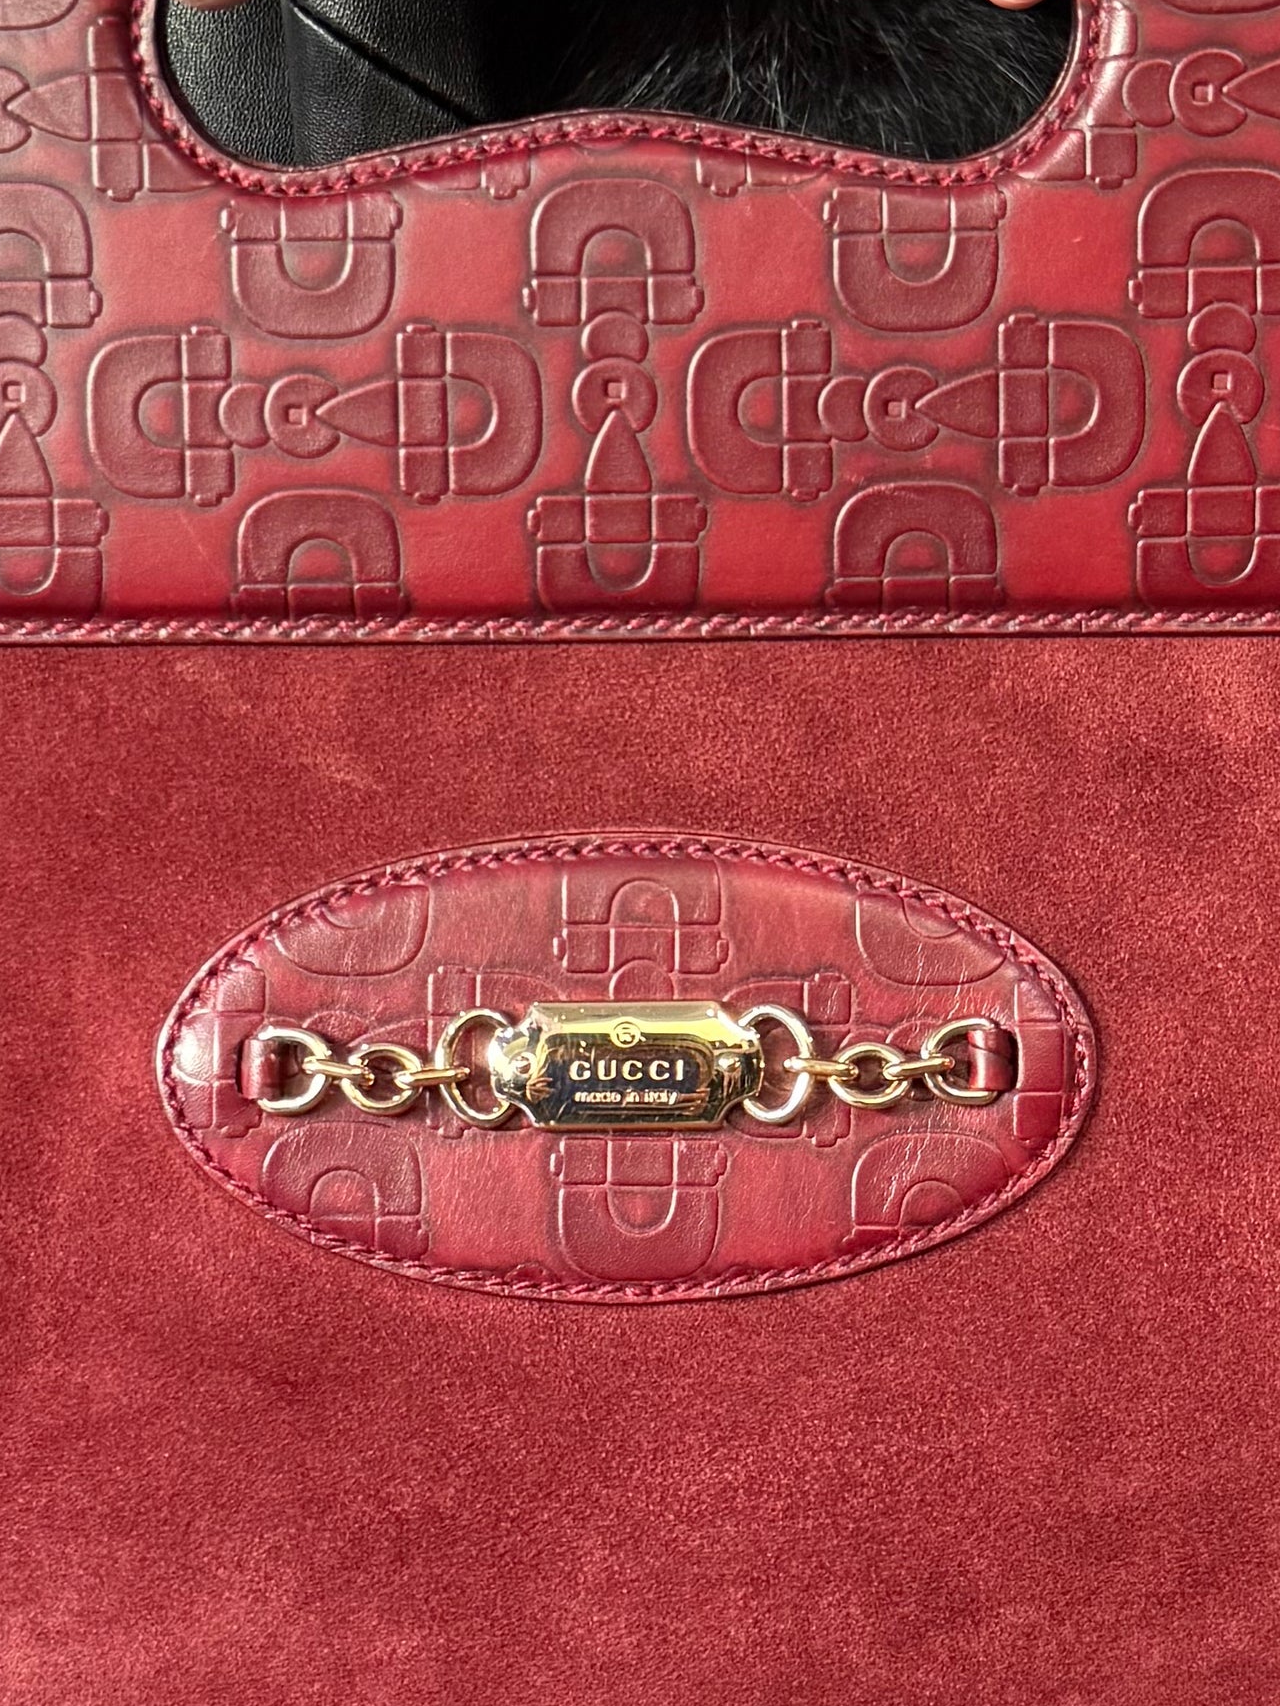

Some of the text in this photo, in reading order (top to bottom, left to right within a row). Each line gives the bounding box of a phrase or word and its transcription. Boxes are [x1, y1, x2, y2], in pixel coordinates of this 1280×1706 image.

[569, 1059, 684, 1081] GUCCI
[574, 1088, 678, 1105] made in italy
